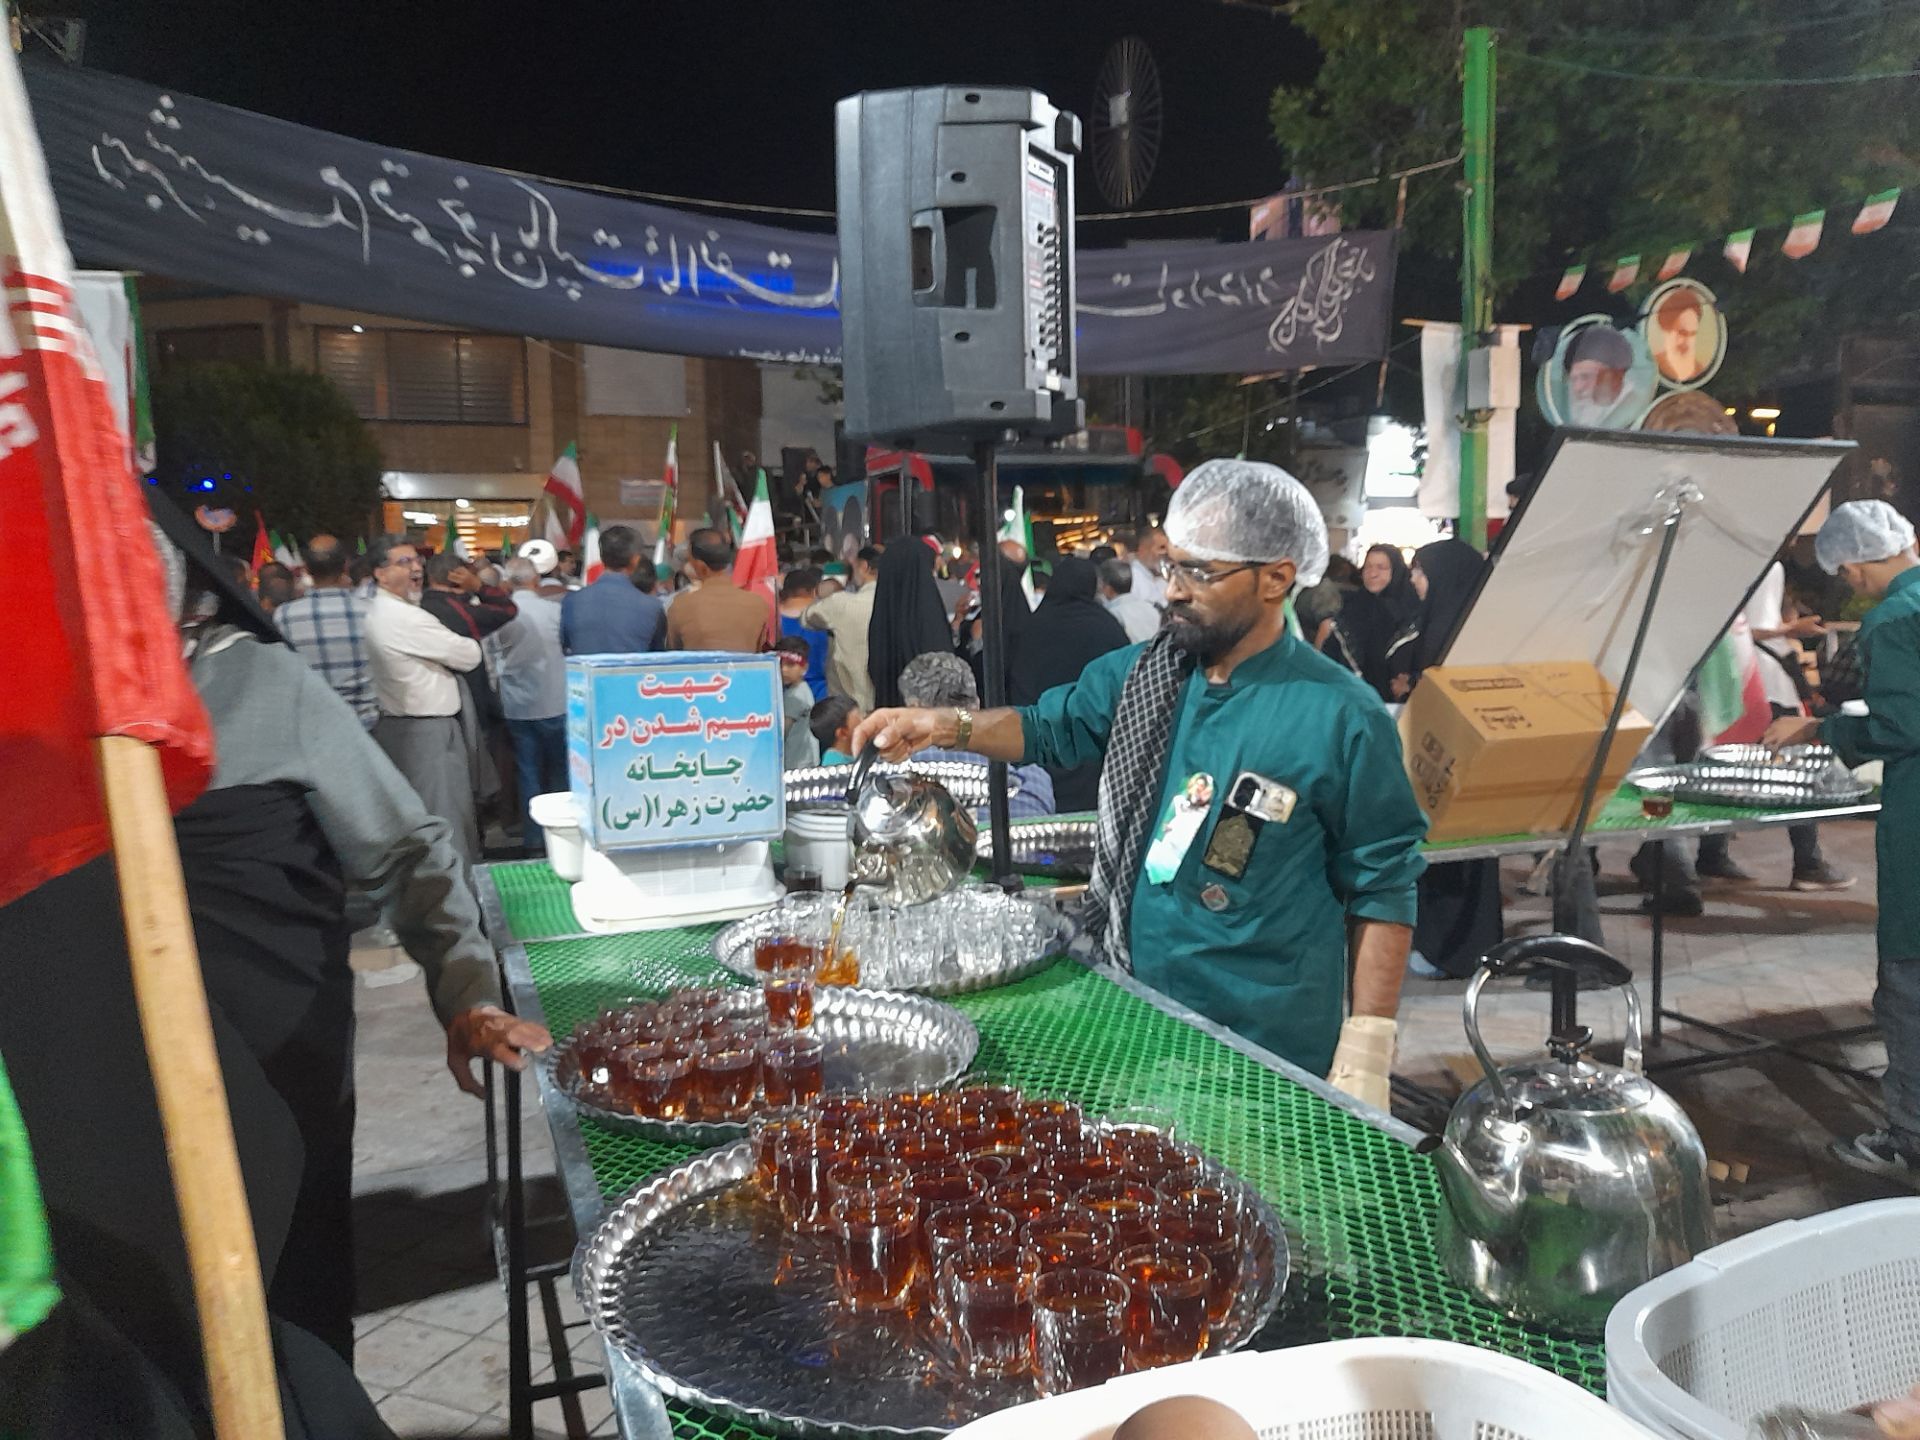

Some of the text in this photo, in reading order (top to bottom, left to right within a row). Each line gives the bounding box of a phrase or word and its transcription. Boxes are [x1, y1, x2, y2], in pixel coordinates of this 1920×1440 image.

[639, 672, 731, 703] جهت
[600, 706, 774, 748] سهیم شدن در
[625, 751, 743, 785] چایخانه
[703, 788, 776, 823] حضرت
